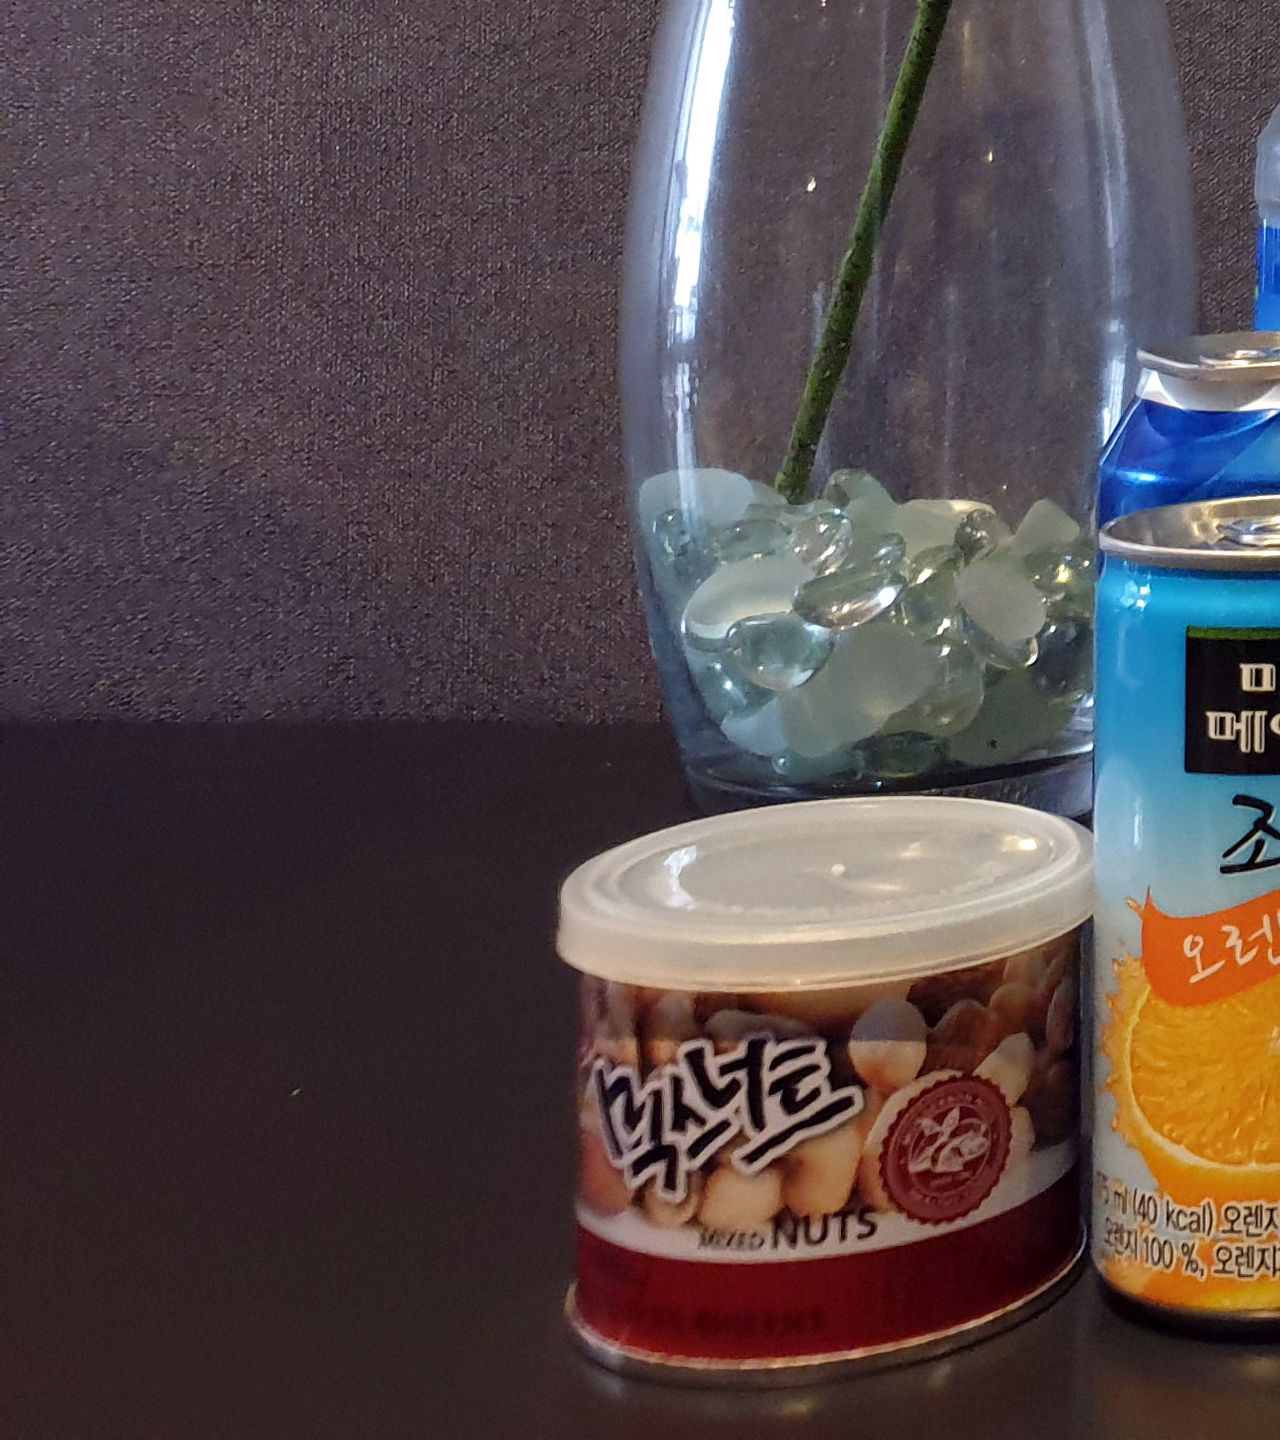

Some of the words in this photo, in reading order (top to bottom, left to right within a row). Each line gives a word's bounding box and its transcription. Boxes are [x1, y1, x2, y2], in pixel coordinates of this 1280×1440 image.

[770, 1205, 879, 1251] NUTS
[1132, 1186, 1158, 1225] (40
[1165, 1199, 1214, 1237] kcal)
[1143, 1235, 1174, 1269] 100
